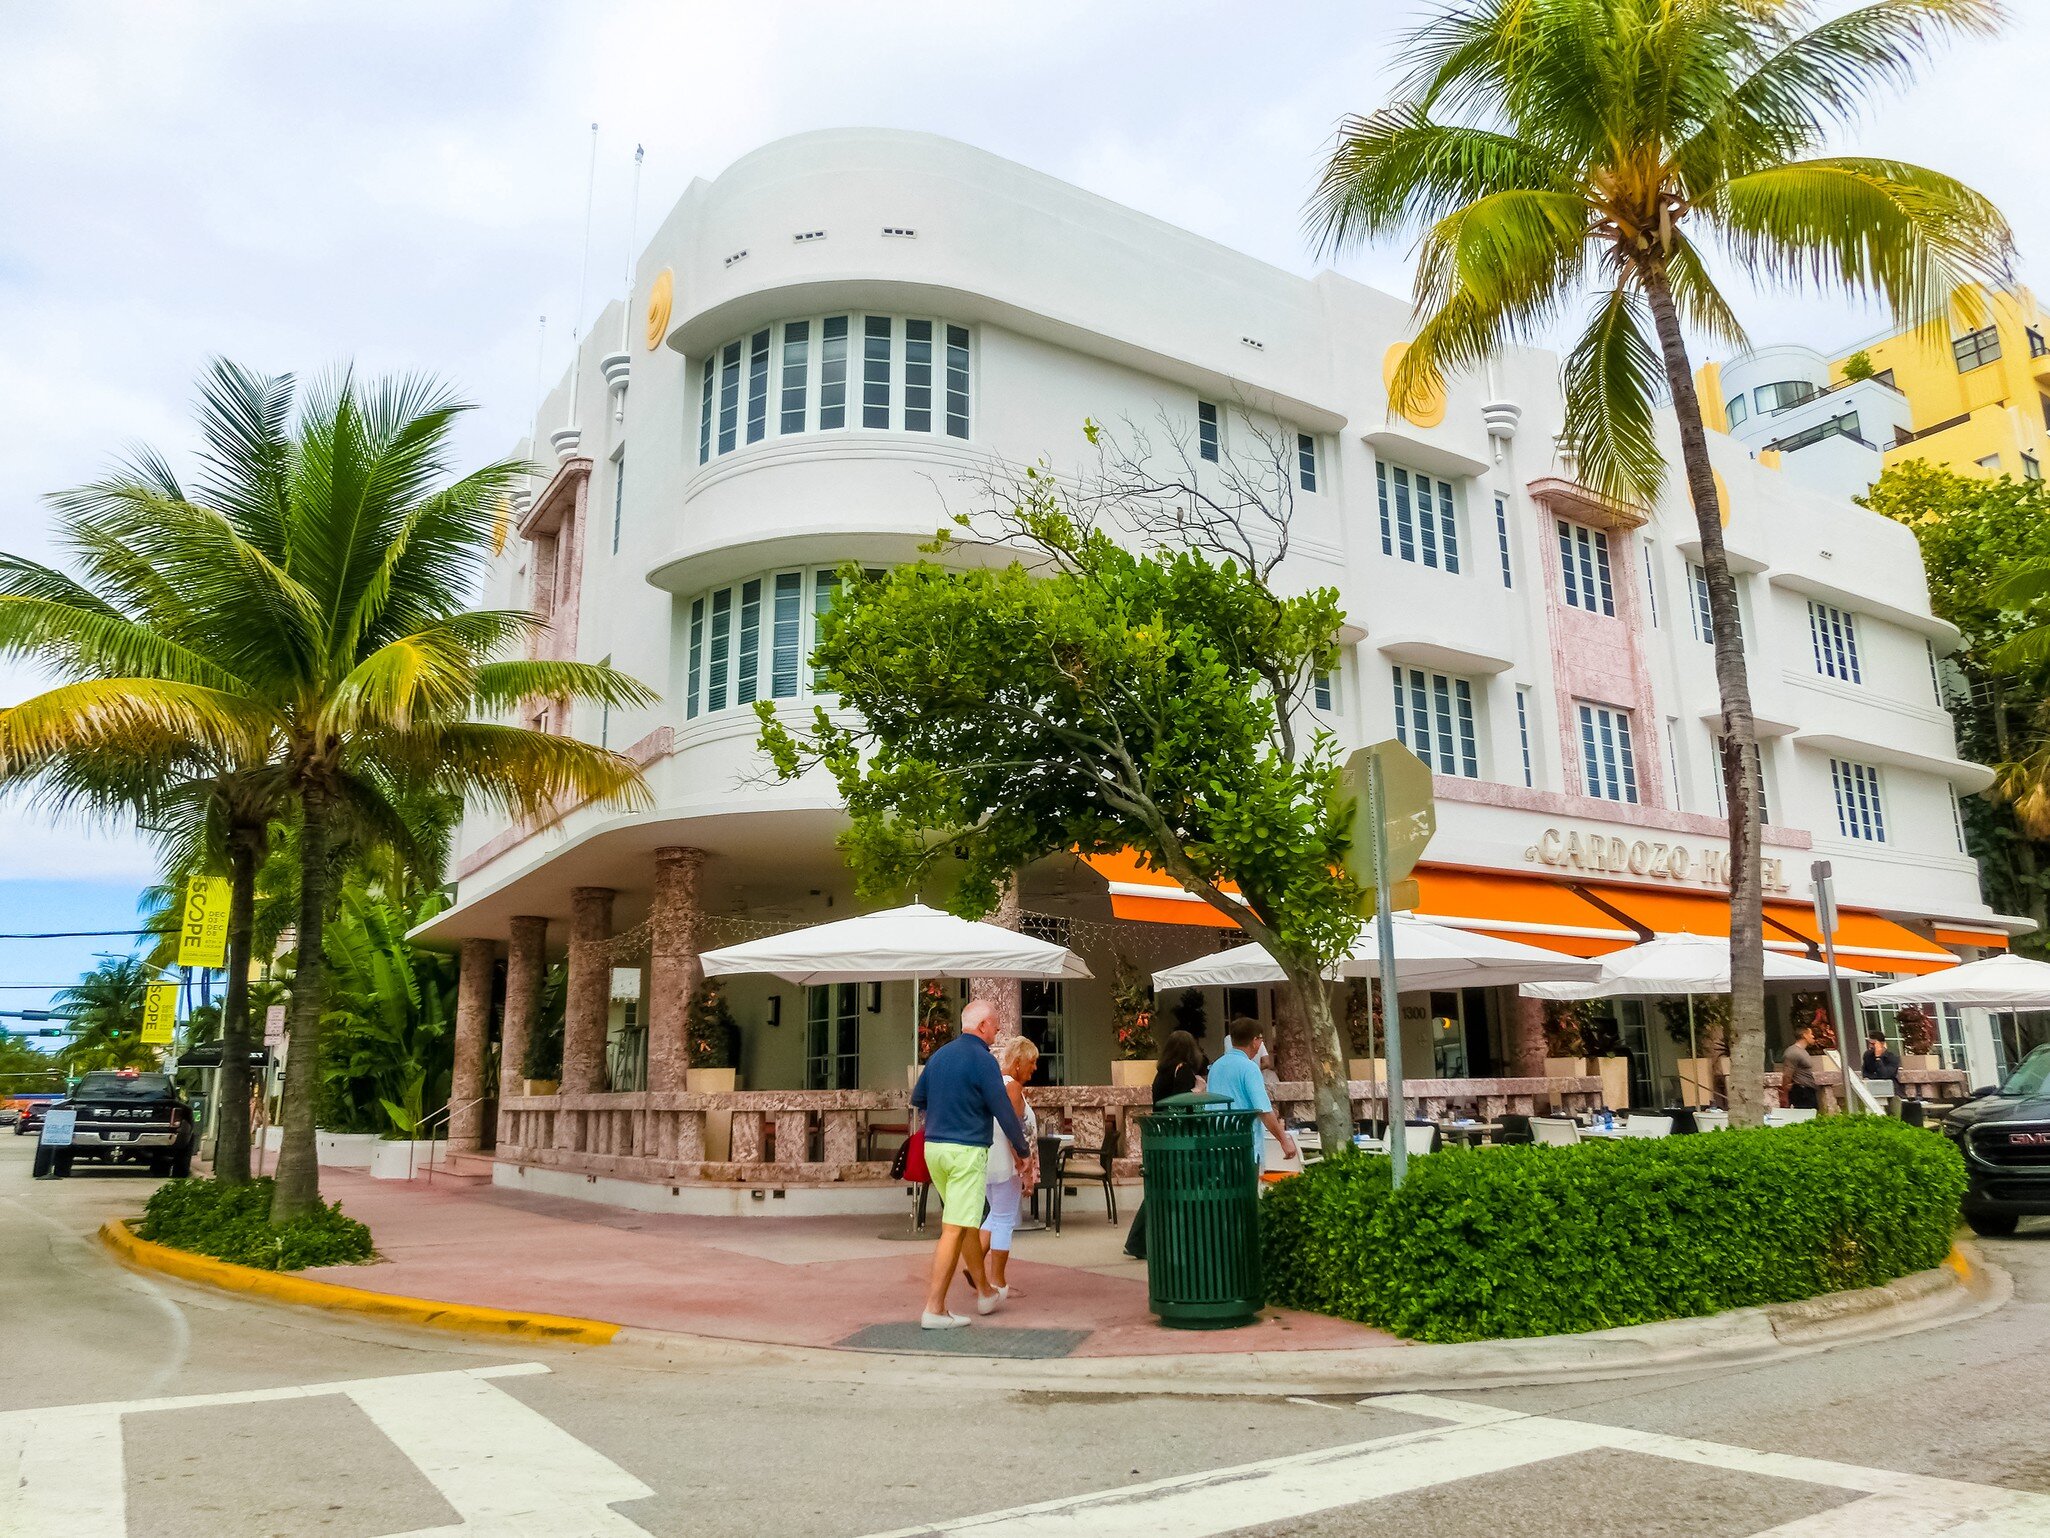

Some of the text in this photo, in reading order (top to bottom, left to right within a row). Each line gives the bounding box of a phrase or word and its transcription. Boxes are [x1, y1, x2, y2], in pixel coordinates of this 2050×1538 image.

[1538, 828, 1792, 893] CARDOZO HEL
[1401, 1006, 1426, 1020] 1300
[93, 1108, 153, 1118] RAM
